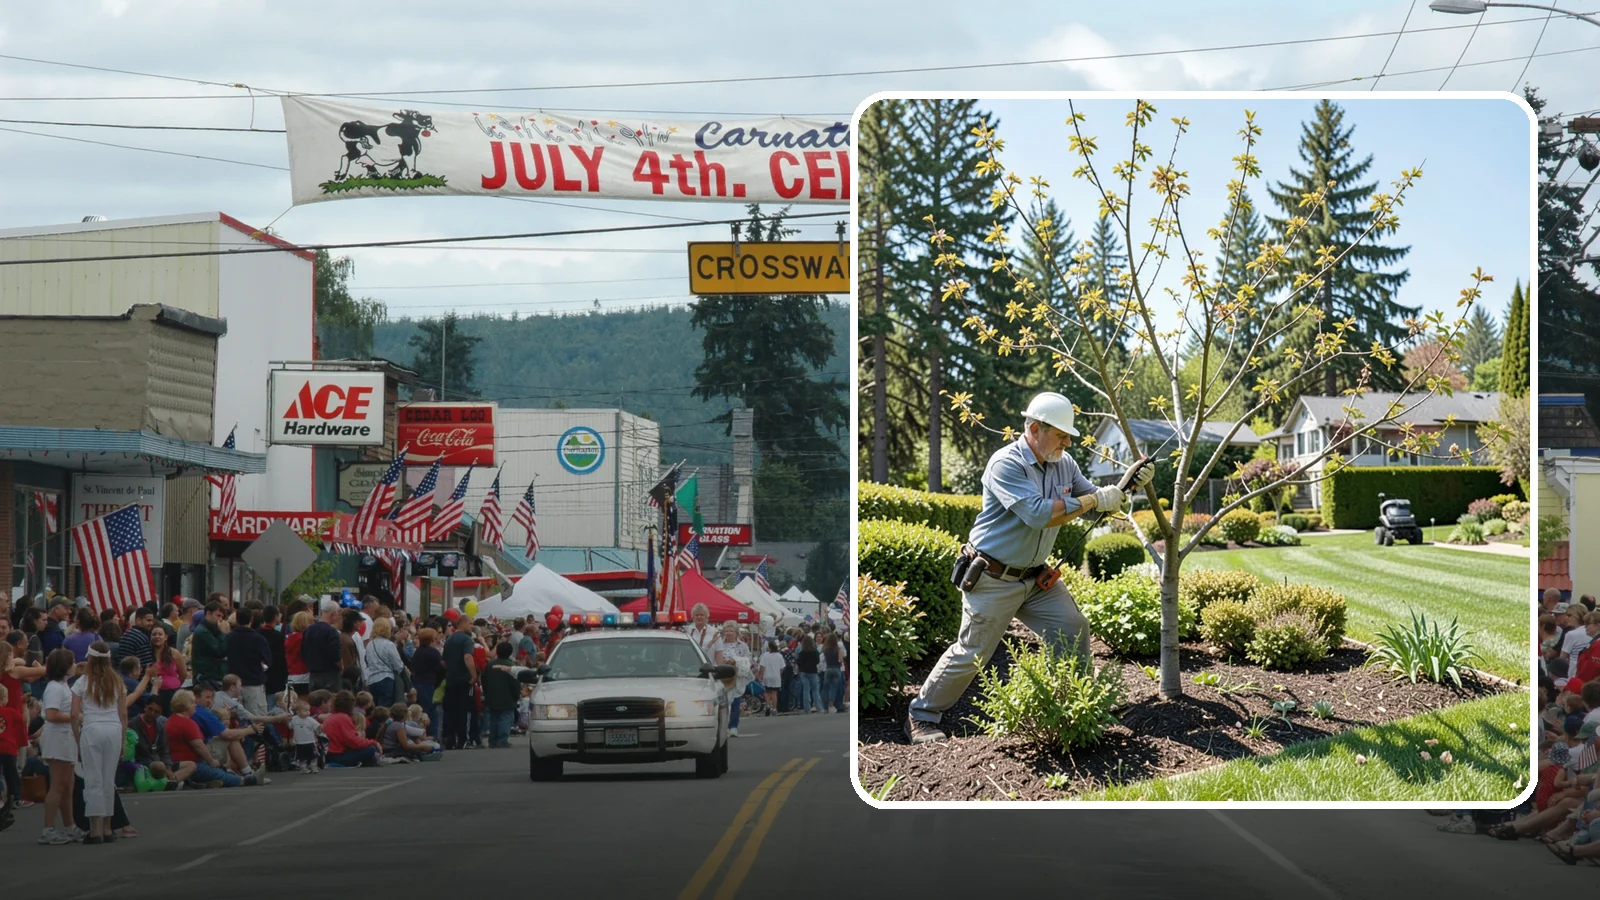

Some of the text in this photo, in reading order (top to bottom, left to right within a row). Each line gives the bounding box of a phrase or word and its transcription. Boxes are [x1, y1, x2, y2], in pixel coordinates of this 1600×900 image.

[481, 141, 605, 192] JULY
[632, 150, 747, 198] 4th.
[697, 254, 850, 280] CROSSWA
[282, 380, 374, 420] ACE
[405, 409, 452, 422] CEDAR
[283, 421, 371, 436] Hardware
[416, 428, 477, 447] Coca-Cola
[354, 467, 386, 480] Simpl
[95, 485, 124, 494] Vincent
[126, 486, 136, 494] de
[137, 486, 155, 495] Paul
[81, 503, 154, 522] THT
[212, 516, 331, 535] HARDARE
[687, 526, 741, 535] CRNATION
[699, 535, 730, 543] GLASS
